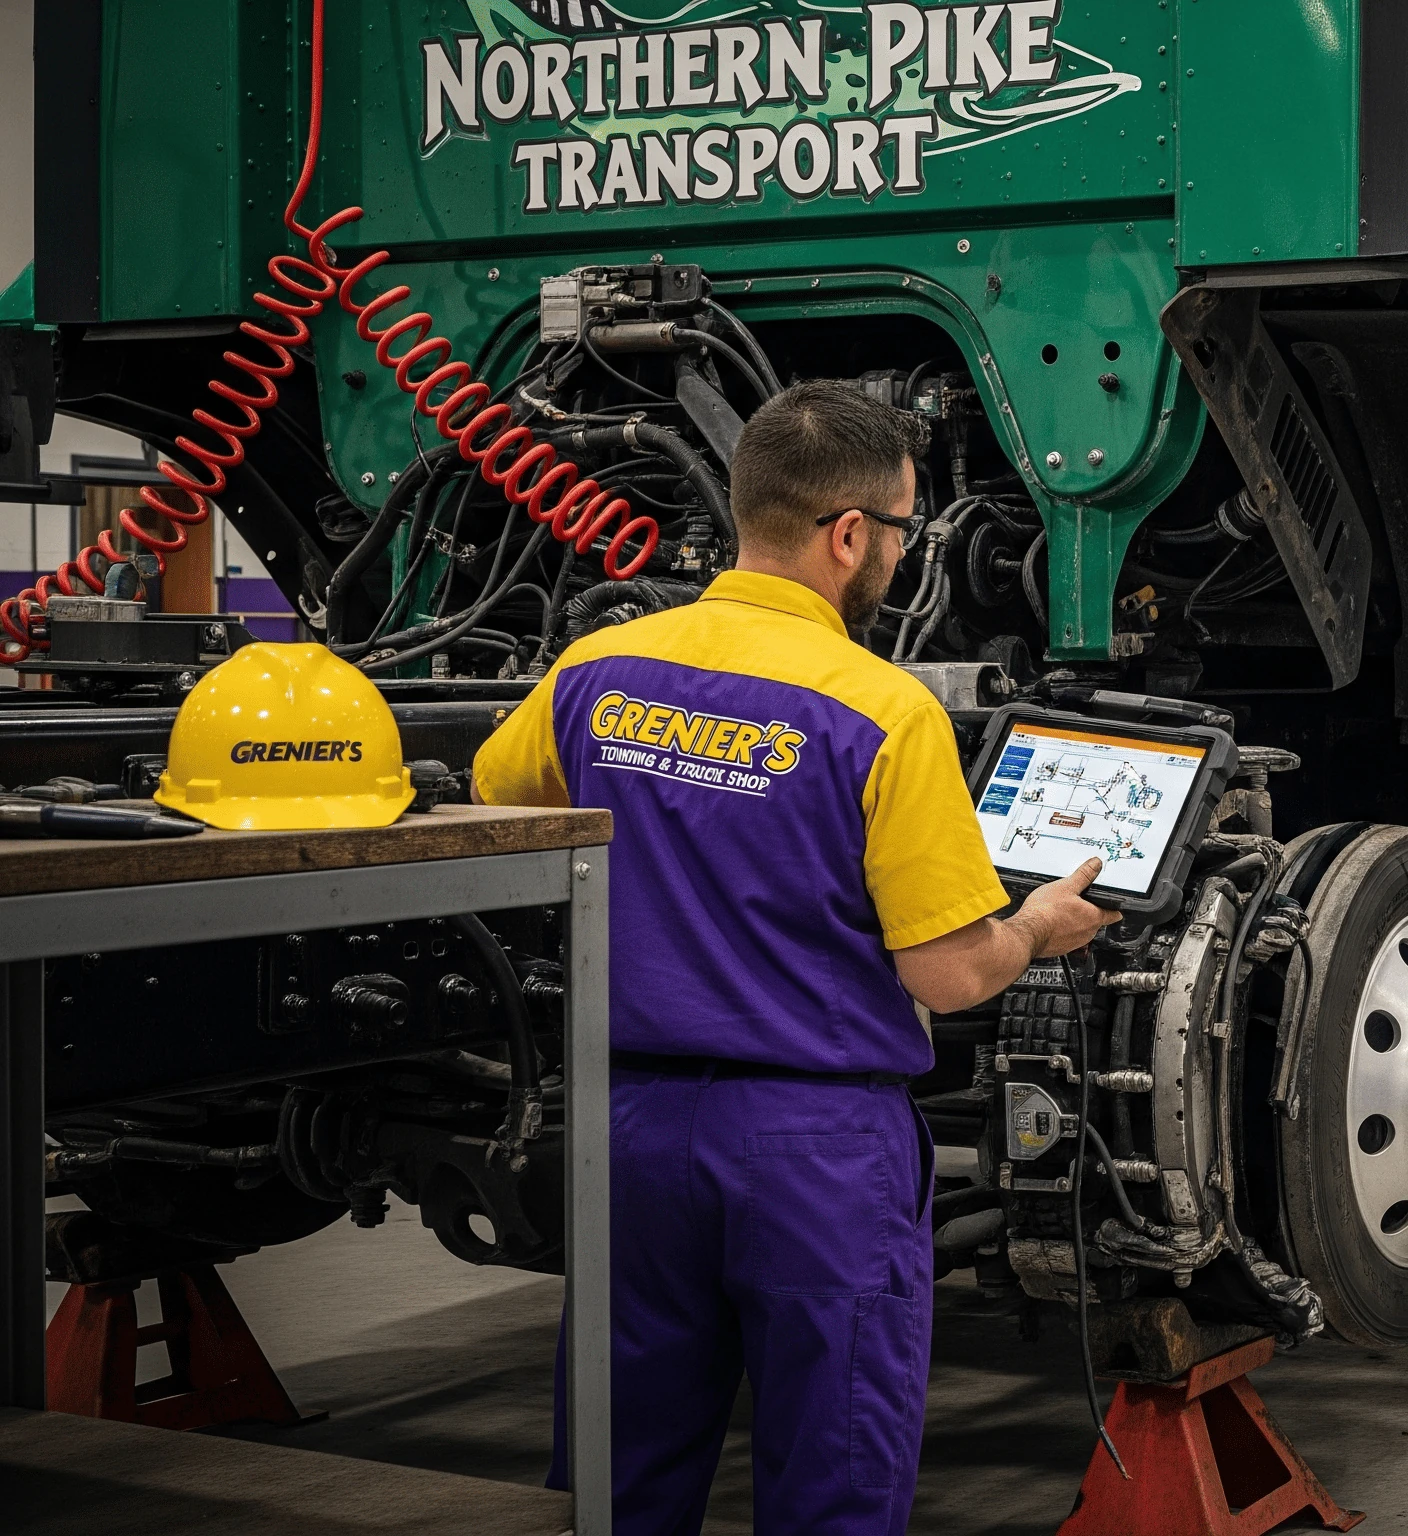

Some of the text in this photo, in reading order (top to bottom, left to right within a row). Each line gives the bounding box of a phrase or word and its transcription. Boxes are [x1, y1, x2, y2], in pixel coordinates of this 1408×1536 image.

[422, 0, 1059, 147] NORTHERN PIKE
[514, 115, 935, 211] TRANSPORT
[230, 739, 363, 764] GRENIER'S
[589, 690, 808, 775] GRENIER'S
[657, 757, 672, 771] &
[726, 770, 771, 791] SHOP
